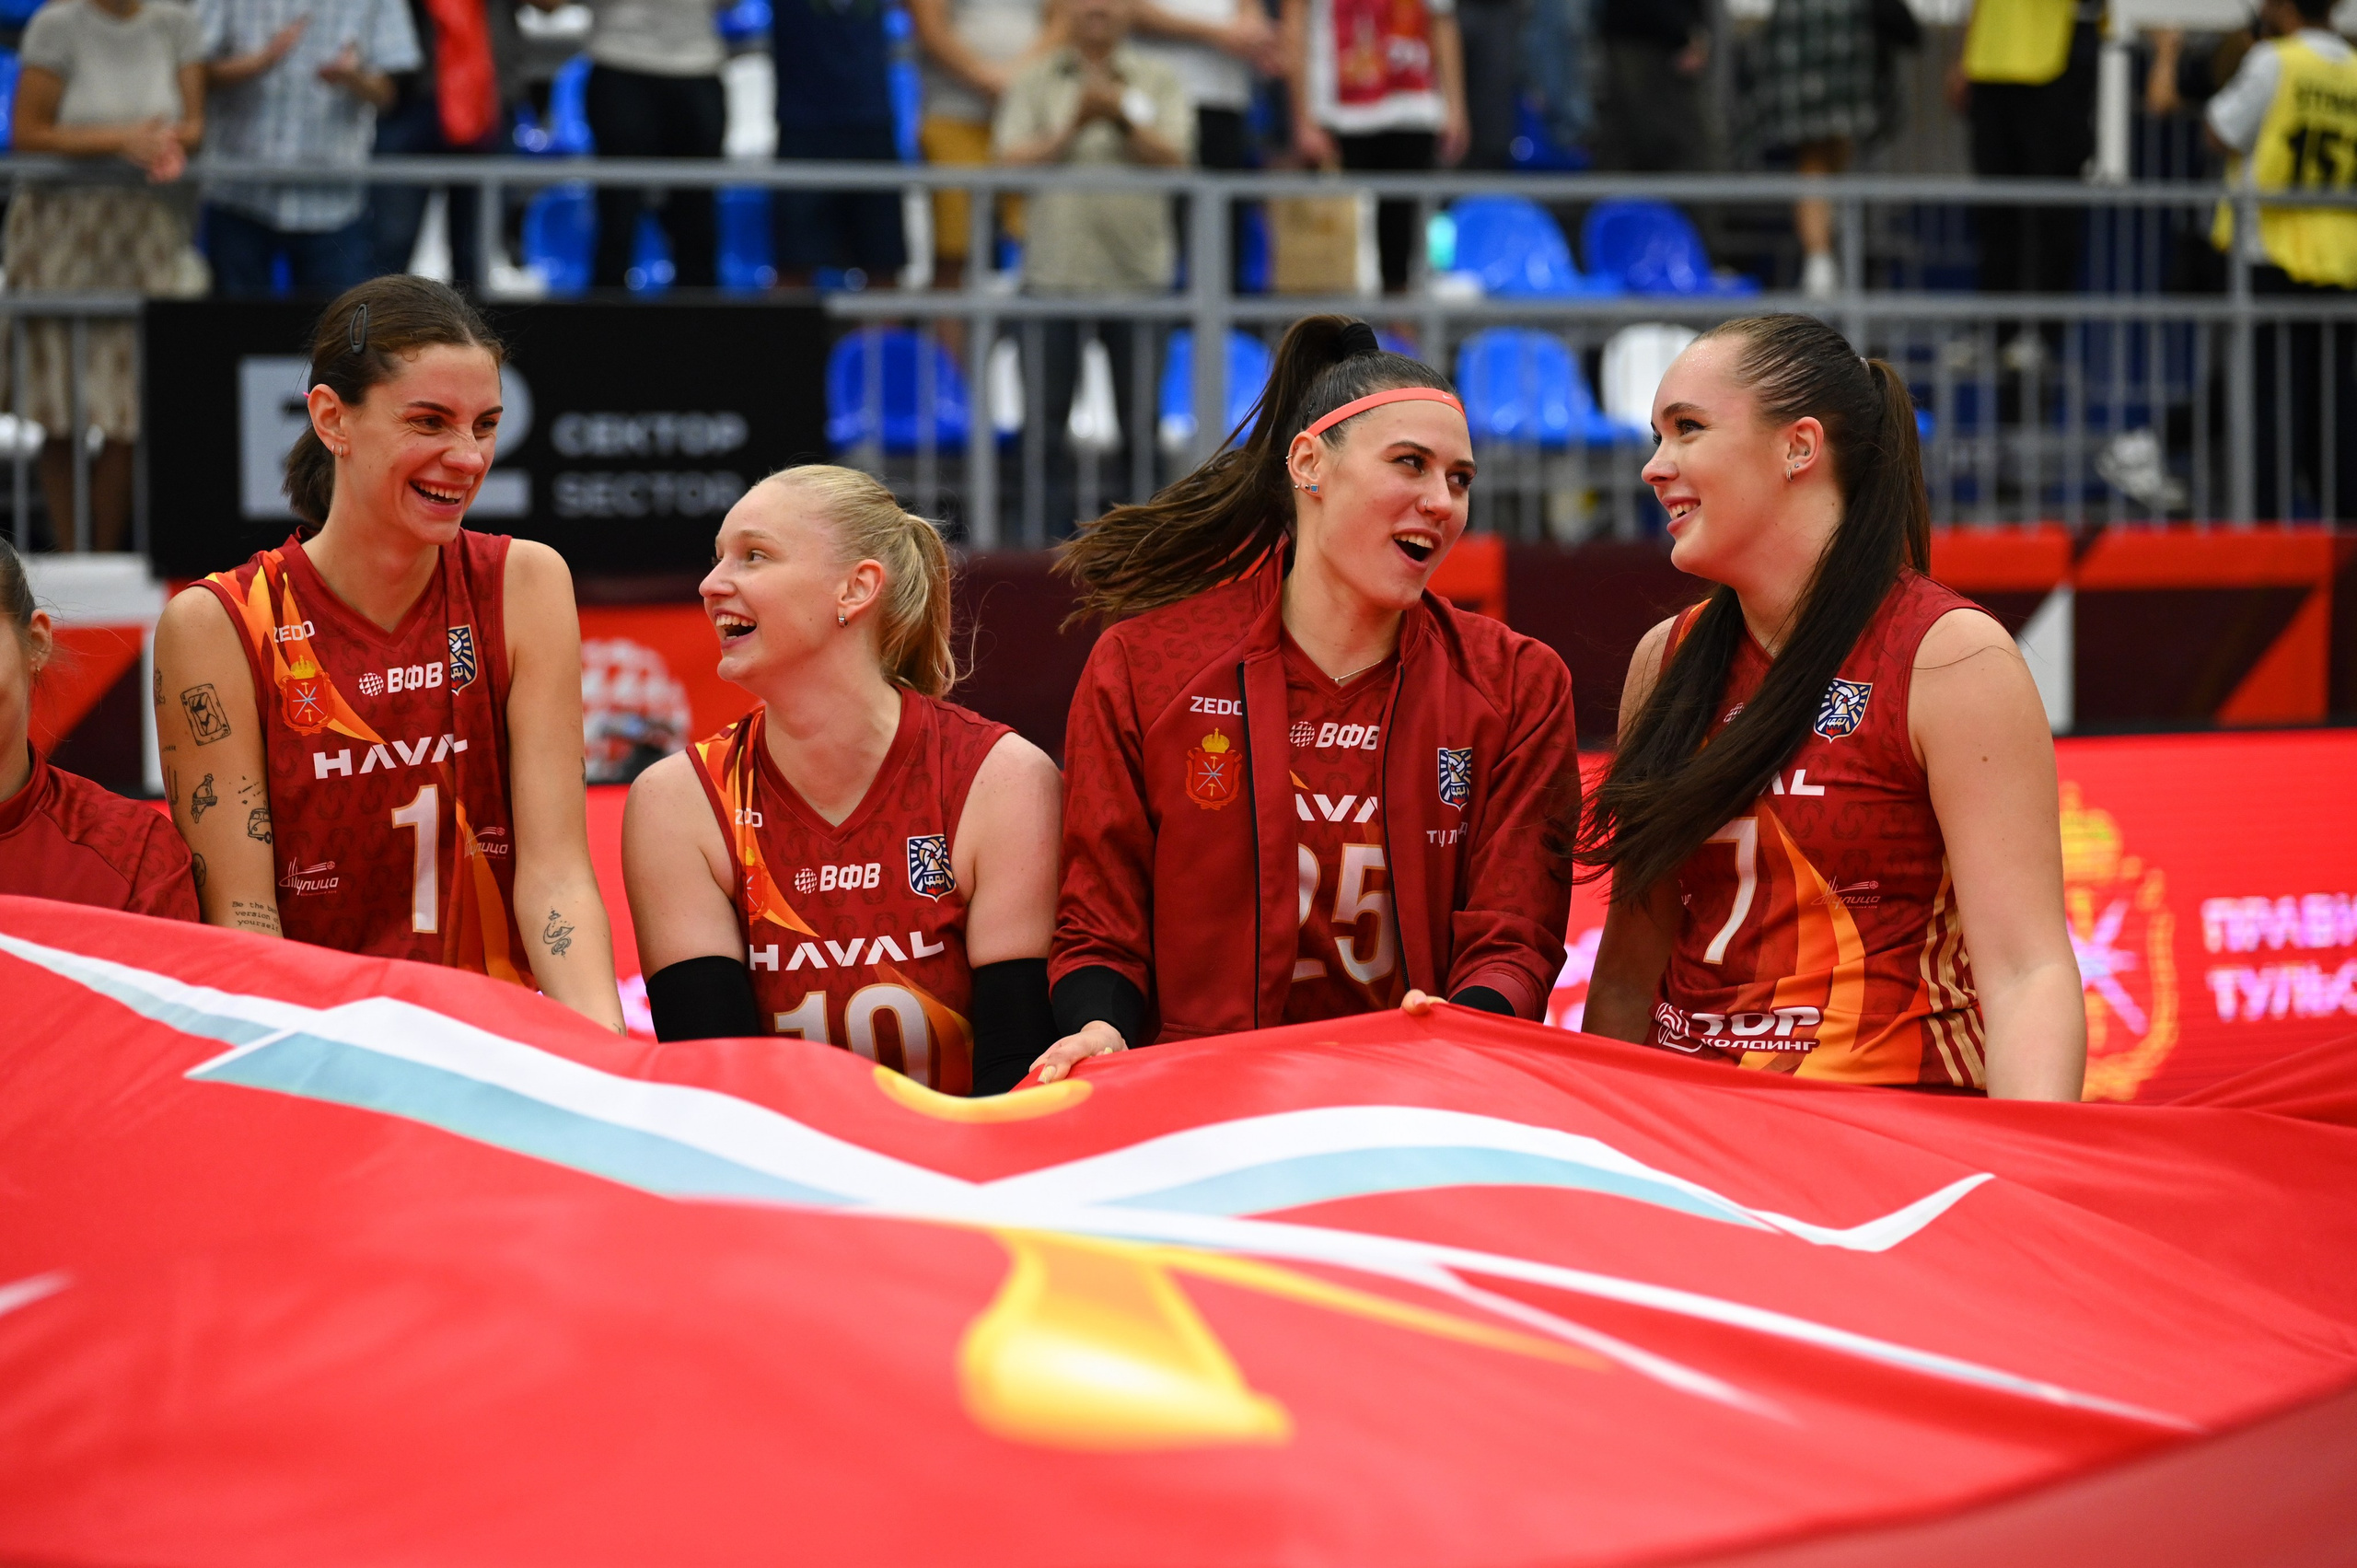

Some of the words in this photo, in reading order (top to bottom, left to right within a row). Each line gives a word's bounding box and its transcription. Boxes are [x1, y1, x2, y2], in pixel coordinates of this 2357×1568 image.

[552, 414, 747, 455] СЕКТОР
[388, 662, 443, 693] ВФВ
[1295, 794, 1377, 823] AVA
[391, 784, 437, 934] 1
[820, 863, 880, 891] ВФВ
[1703, 817, 1758, 965] 7
[749, 931, 945, 971] HAVAL
